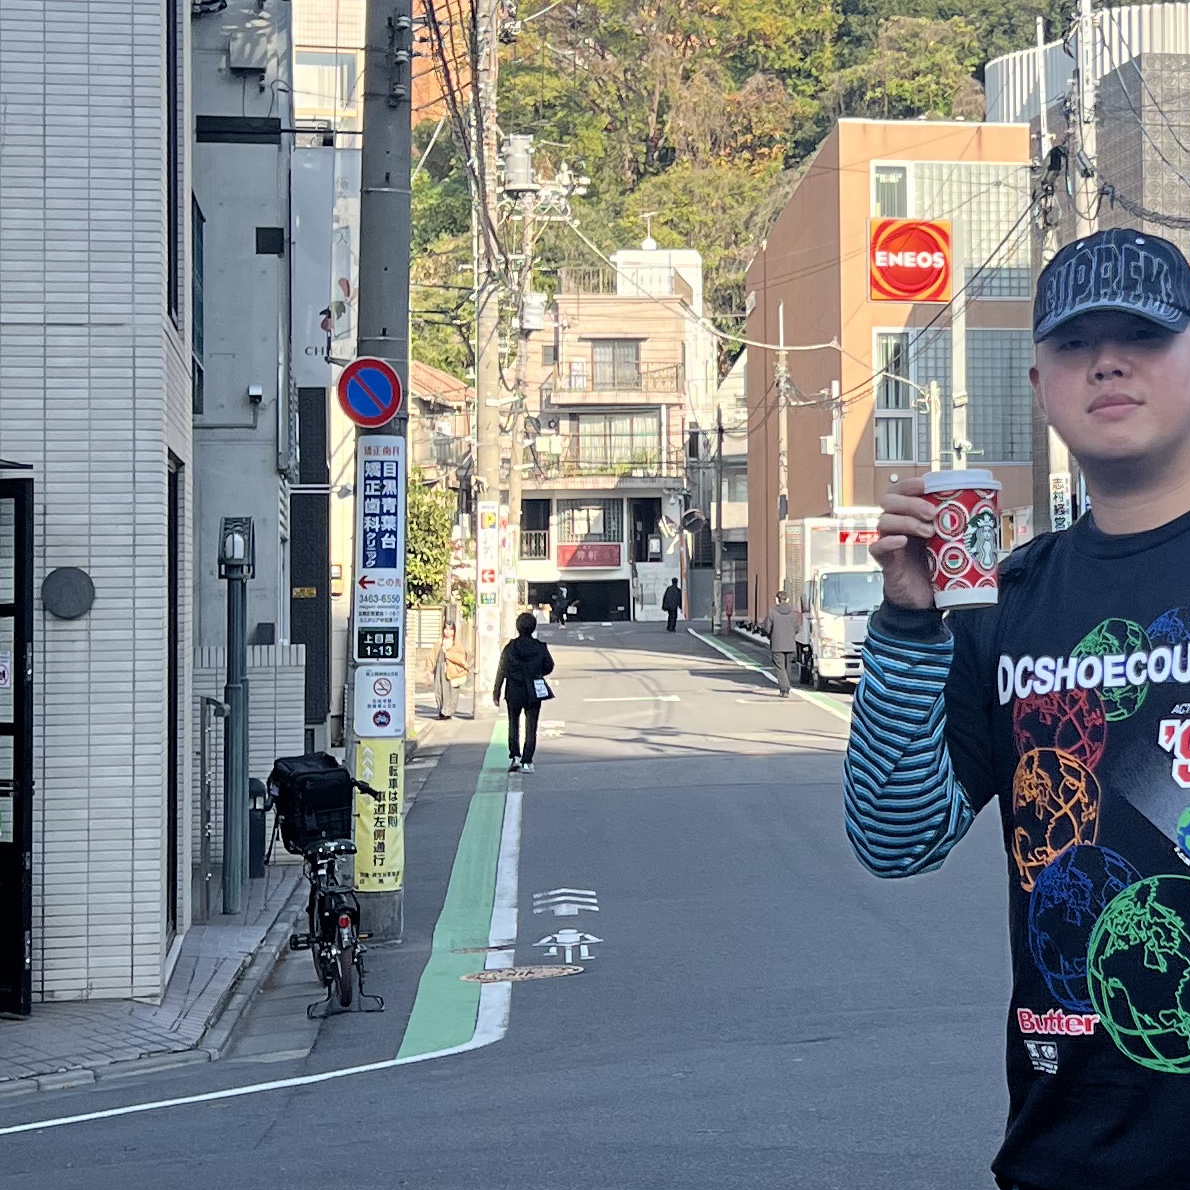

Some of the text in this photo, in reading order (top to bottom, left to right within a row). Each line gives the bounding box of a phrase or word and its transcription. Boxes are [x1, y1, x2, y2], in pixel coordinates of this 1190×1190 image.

[875, 251, 945, 269] ENEOS
[364, 462, 381, 568] 矯正歯科クリニック
[381, 462, 397, 550] 目黒青葉台
[359, 594, 400, 604] 3463-6550
[363, 633, 395, 644] 上目黒
[366, 645, 393, 656] 1-13
[388, 752, 399, 828] 自転車は原則
[373, 790, 387, 867] 車道左側通行
[1017, 1008, 1100, 1036] Butter
